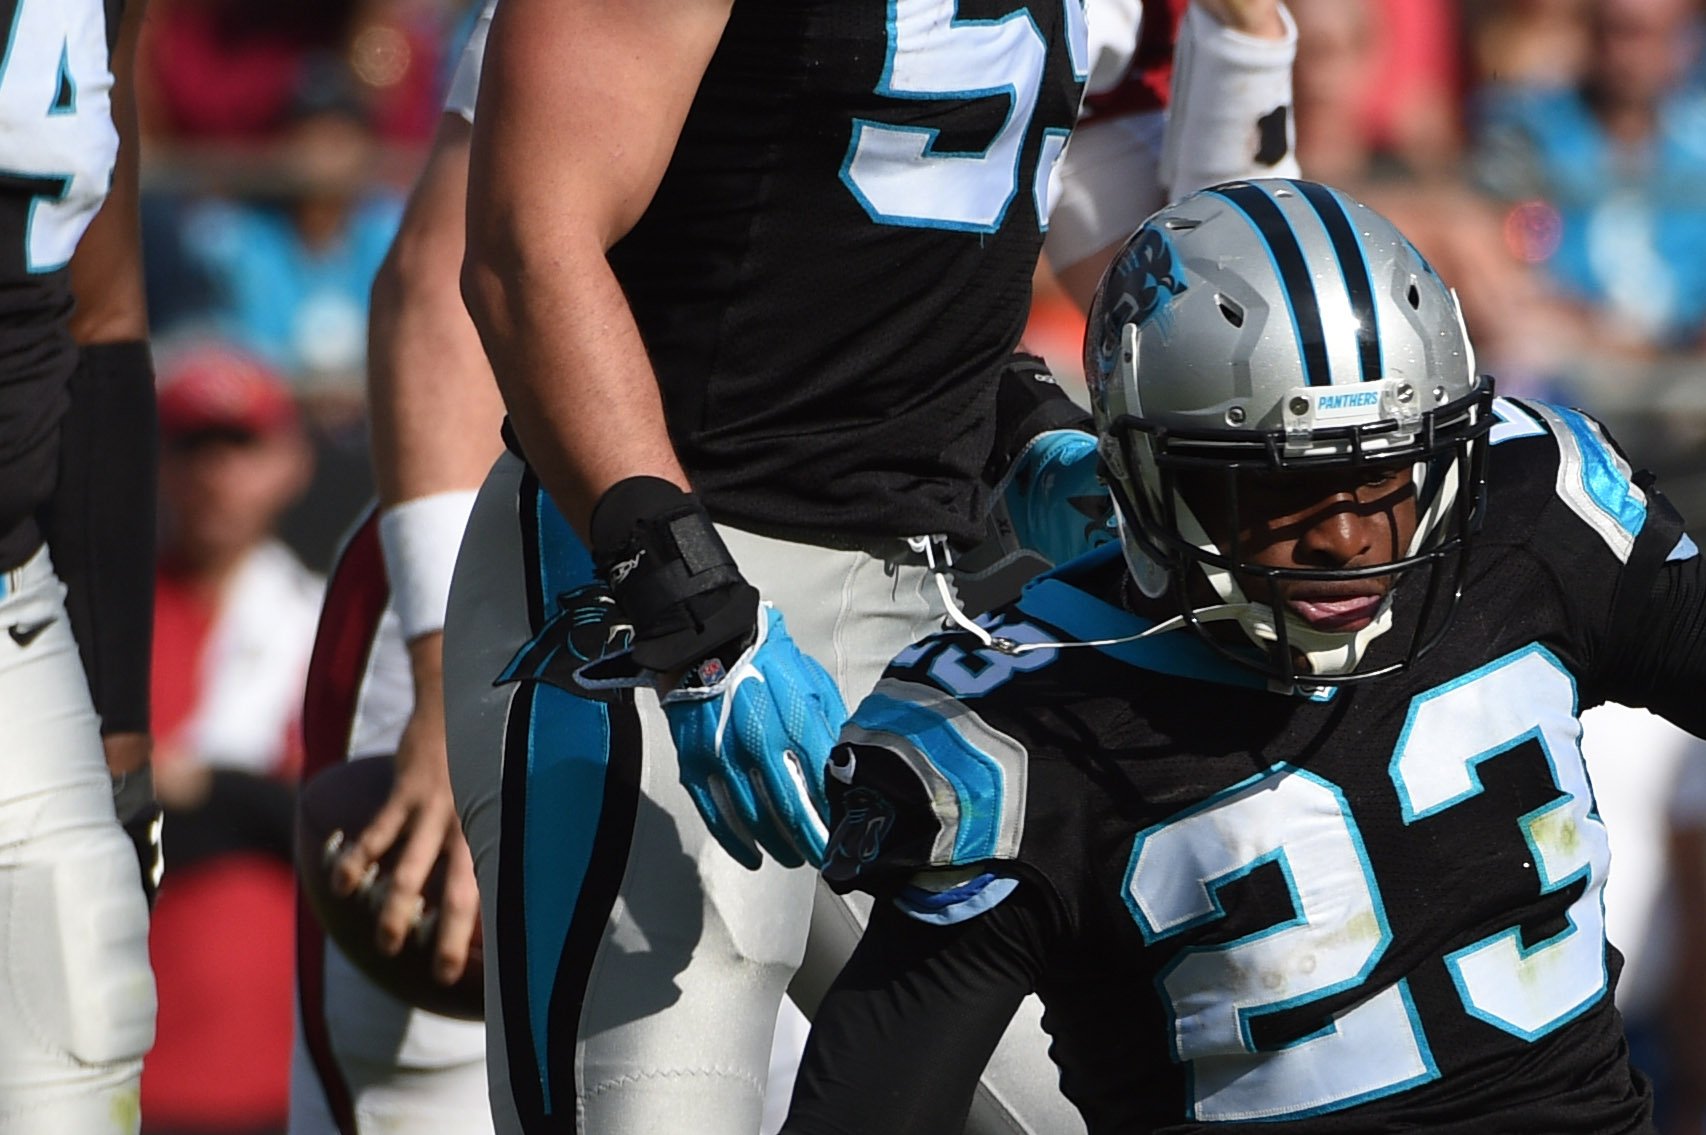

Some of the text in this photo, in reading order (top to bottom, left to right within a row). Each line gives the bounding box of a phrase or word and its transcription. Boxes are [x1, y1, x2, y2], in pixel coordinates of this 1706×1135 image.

[838, 0, 1088, 234] 5
[1318, 391, 1378, 410] PANTHERS
[1120, 641, 1612, 1124] 23
